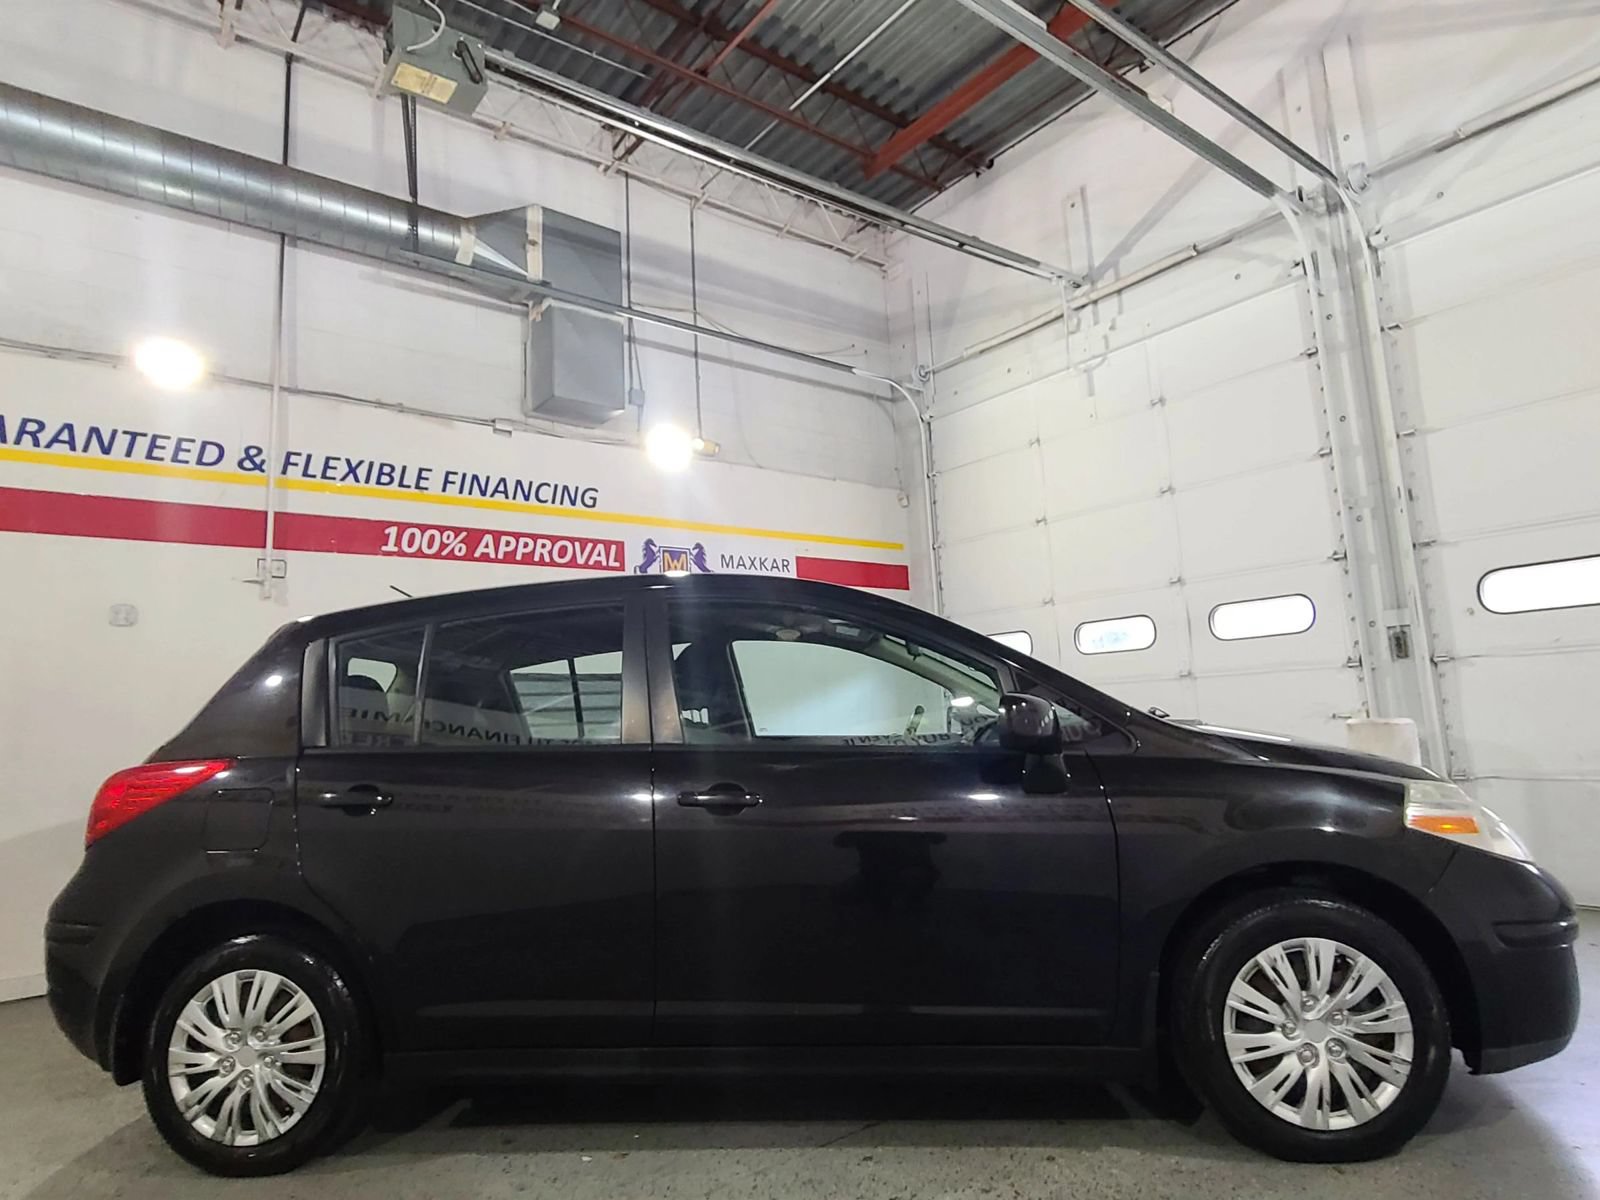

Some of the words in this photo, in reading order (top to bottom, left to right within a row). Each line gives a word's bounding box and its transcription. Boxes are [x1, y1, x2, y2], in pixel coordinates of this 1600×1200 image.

[0, 414, 225, 467] RANTEED
[237, 445, 266, 473] &
[280, 450, 432, 491] FLEXIBLE
[441, 471, 599, 509] FINANCING
[380, 525, 467, 558] 100%
[474, 532, 622, 569] APPROVAL
[720, 553, 791, 573] MAXKAR
